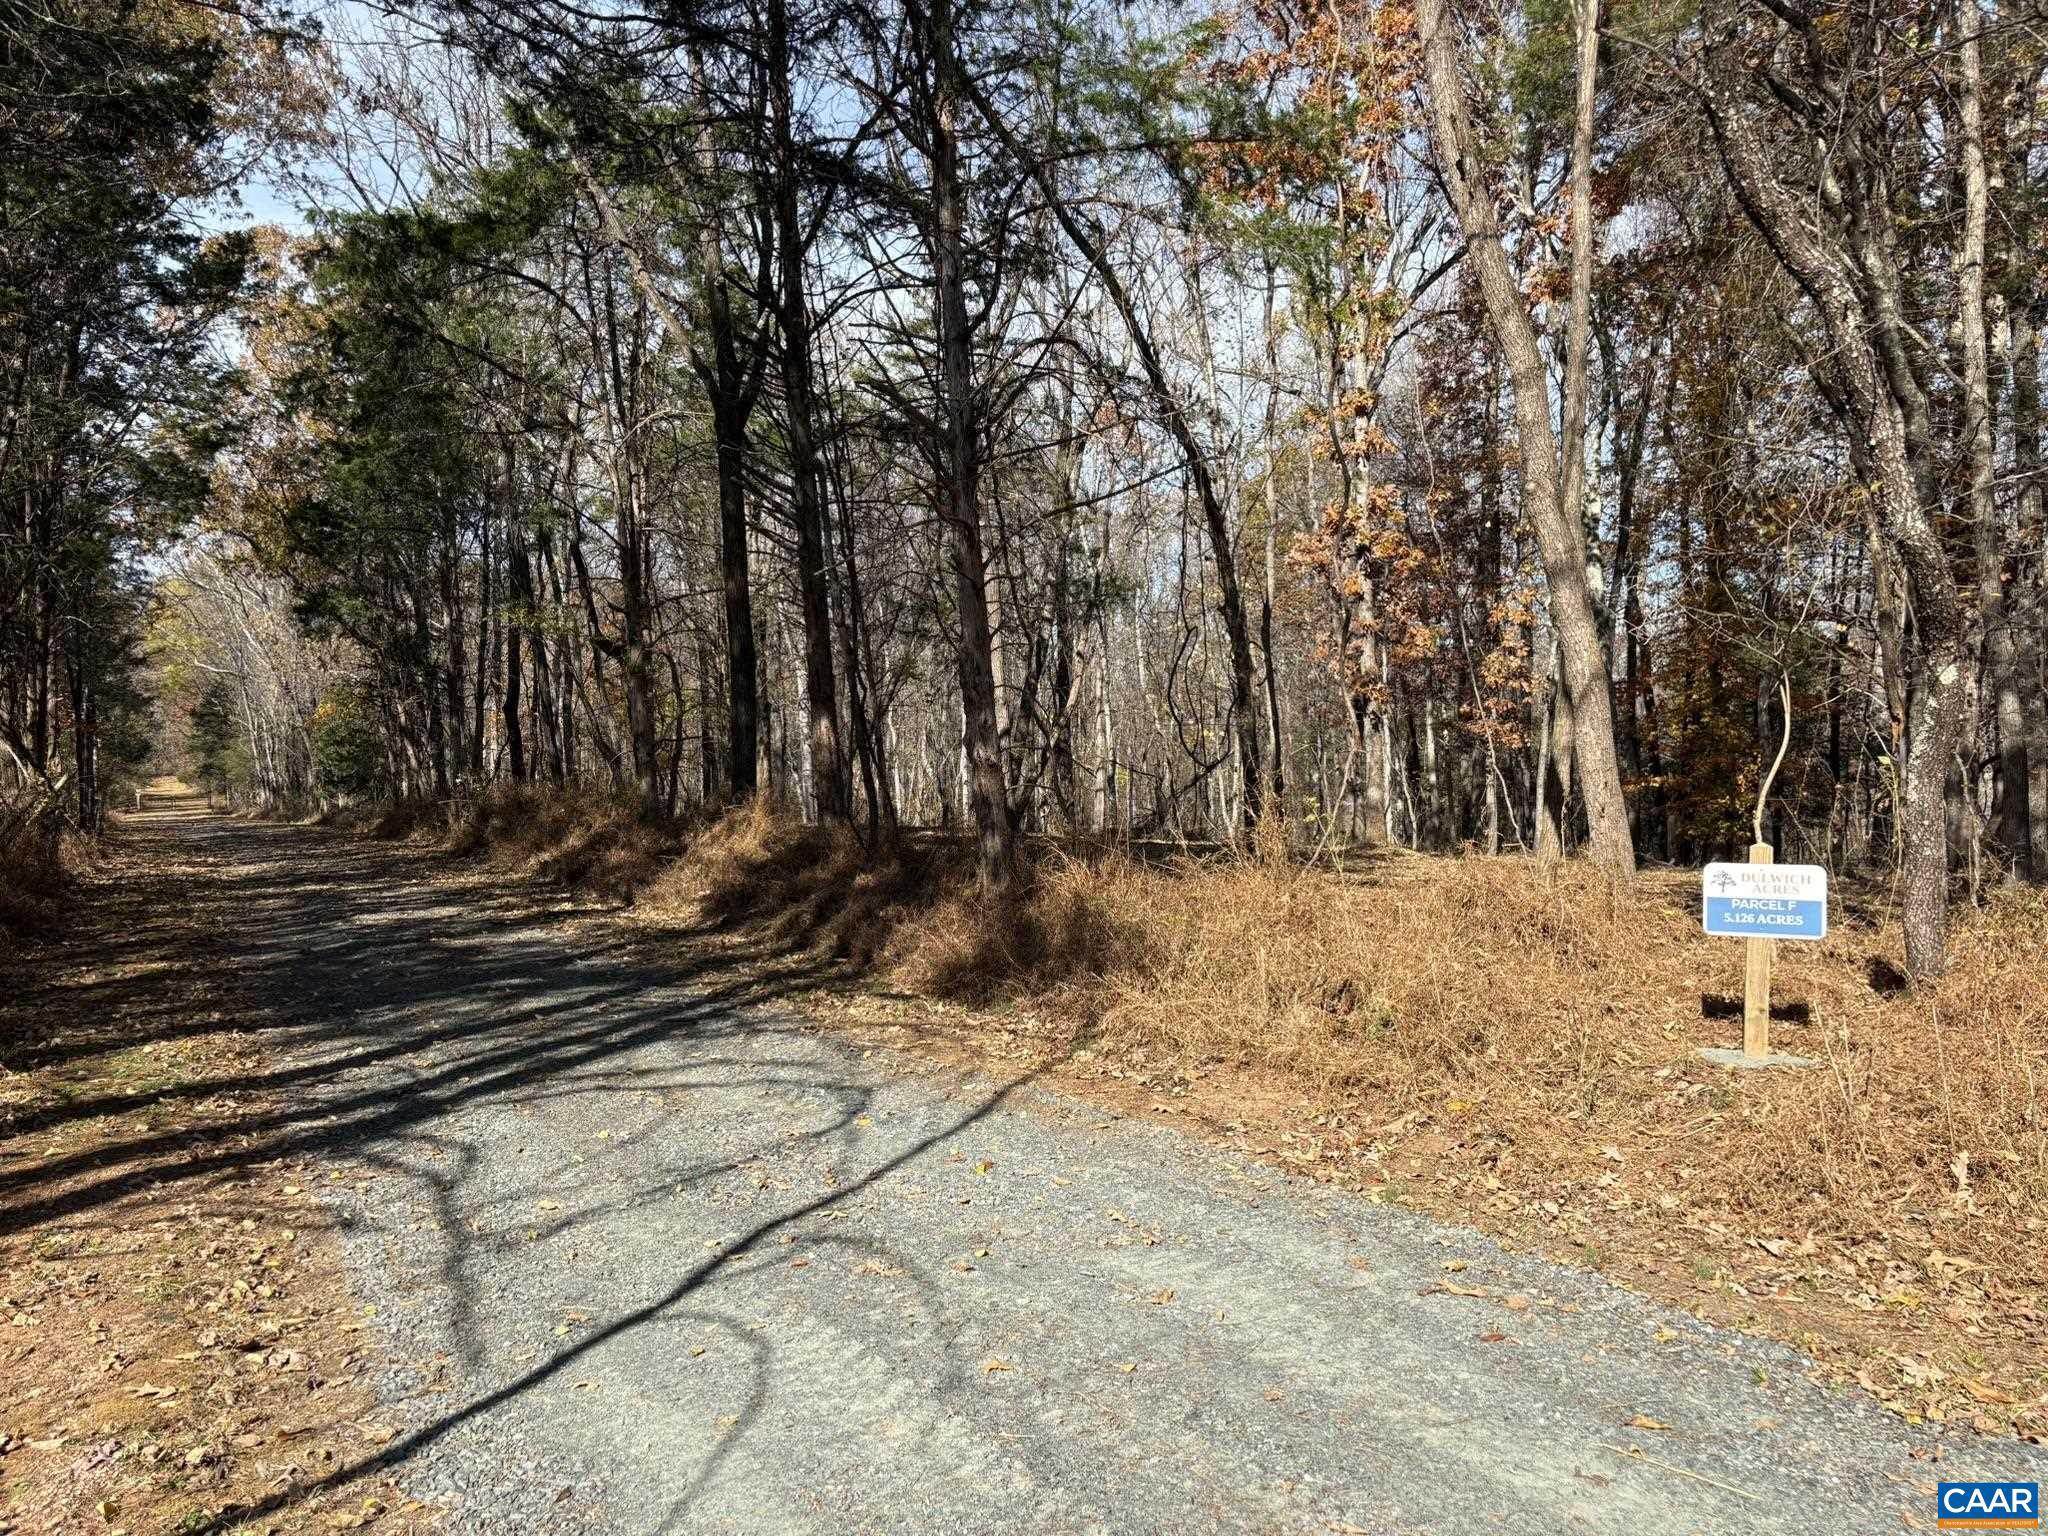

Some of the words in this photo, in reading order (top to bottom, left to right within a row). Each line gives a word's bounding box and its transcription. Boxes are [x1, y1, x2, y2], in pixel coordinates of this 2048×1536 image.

[1741, 872, 1811, 885] DULWICH
[1753, 885, 1800, 895] ACRES
[1731, 898, 1785, 910] PARCEL
[1788, 900, 1797, 911] F
[1723, 912, 1755, 923] 5.126
[1757, 914, 1804, 926] ACRES
